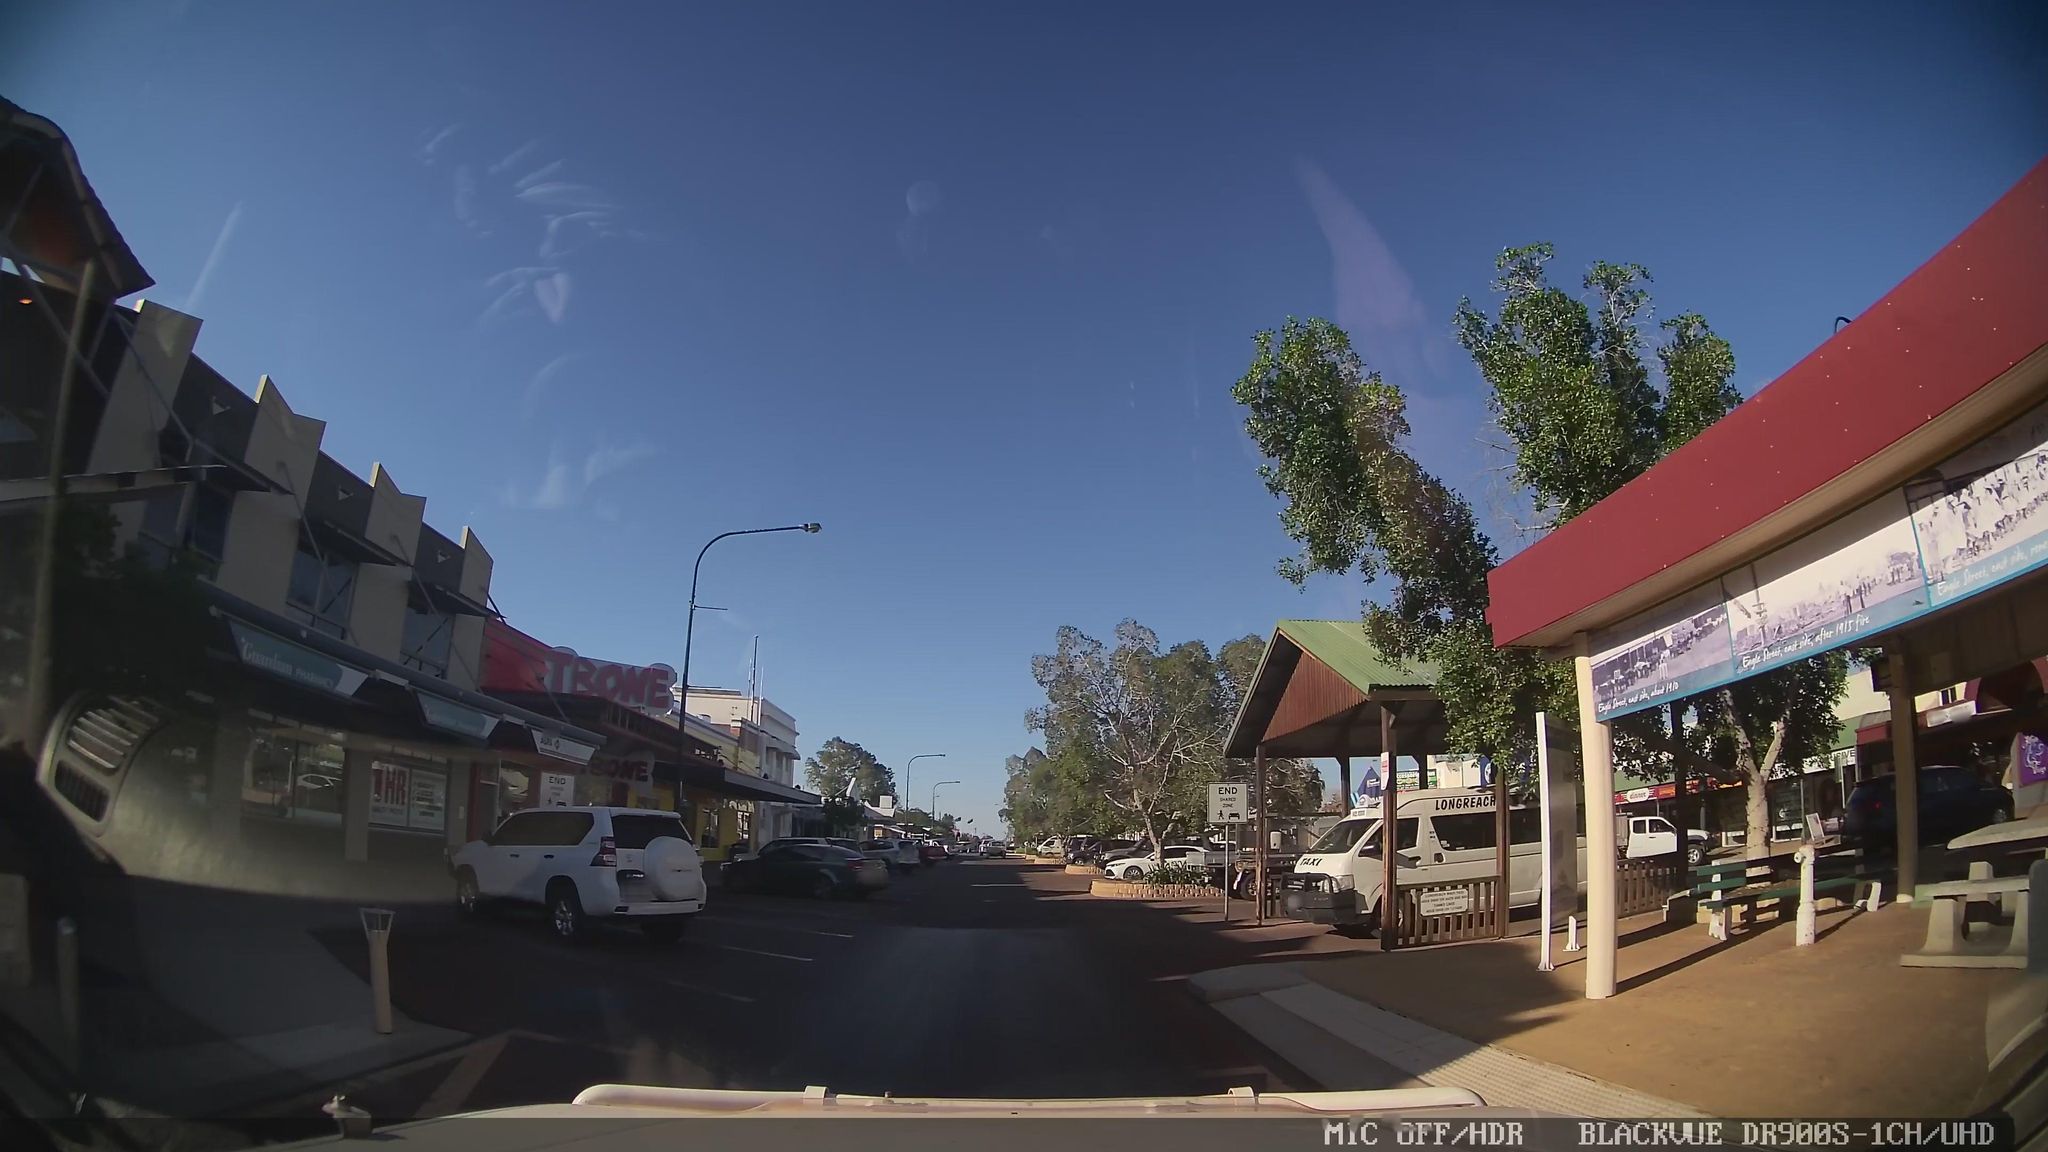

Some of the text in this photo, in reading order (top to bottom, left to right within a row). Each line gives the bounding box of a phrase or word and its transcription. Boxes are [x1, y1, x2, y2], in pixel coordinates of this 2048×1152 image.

[1742, 655, 1761, 670] Eagle
[1815, 627, 1834, 643] after
[1836, 619, 1852, 637] 1915
[1855, 613, 1871, 632] fire
[1598, 702, 1612, 716] Eagle
[1650, 684, 1665, 697] about
[1665, 681, 1679, 693] 1910
[548, 776, 567, 786] END
[1218, 786, 1238, 795] END
[1435, 796, 1496, 810] LONGREACH
[1300, 857, 1323, 866] TAXI
